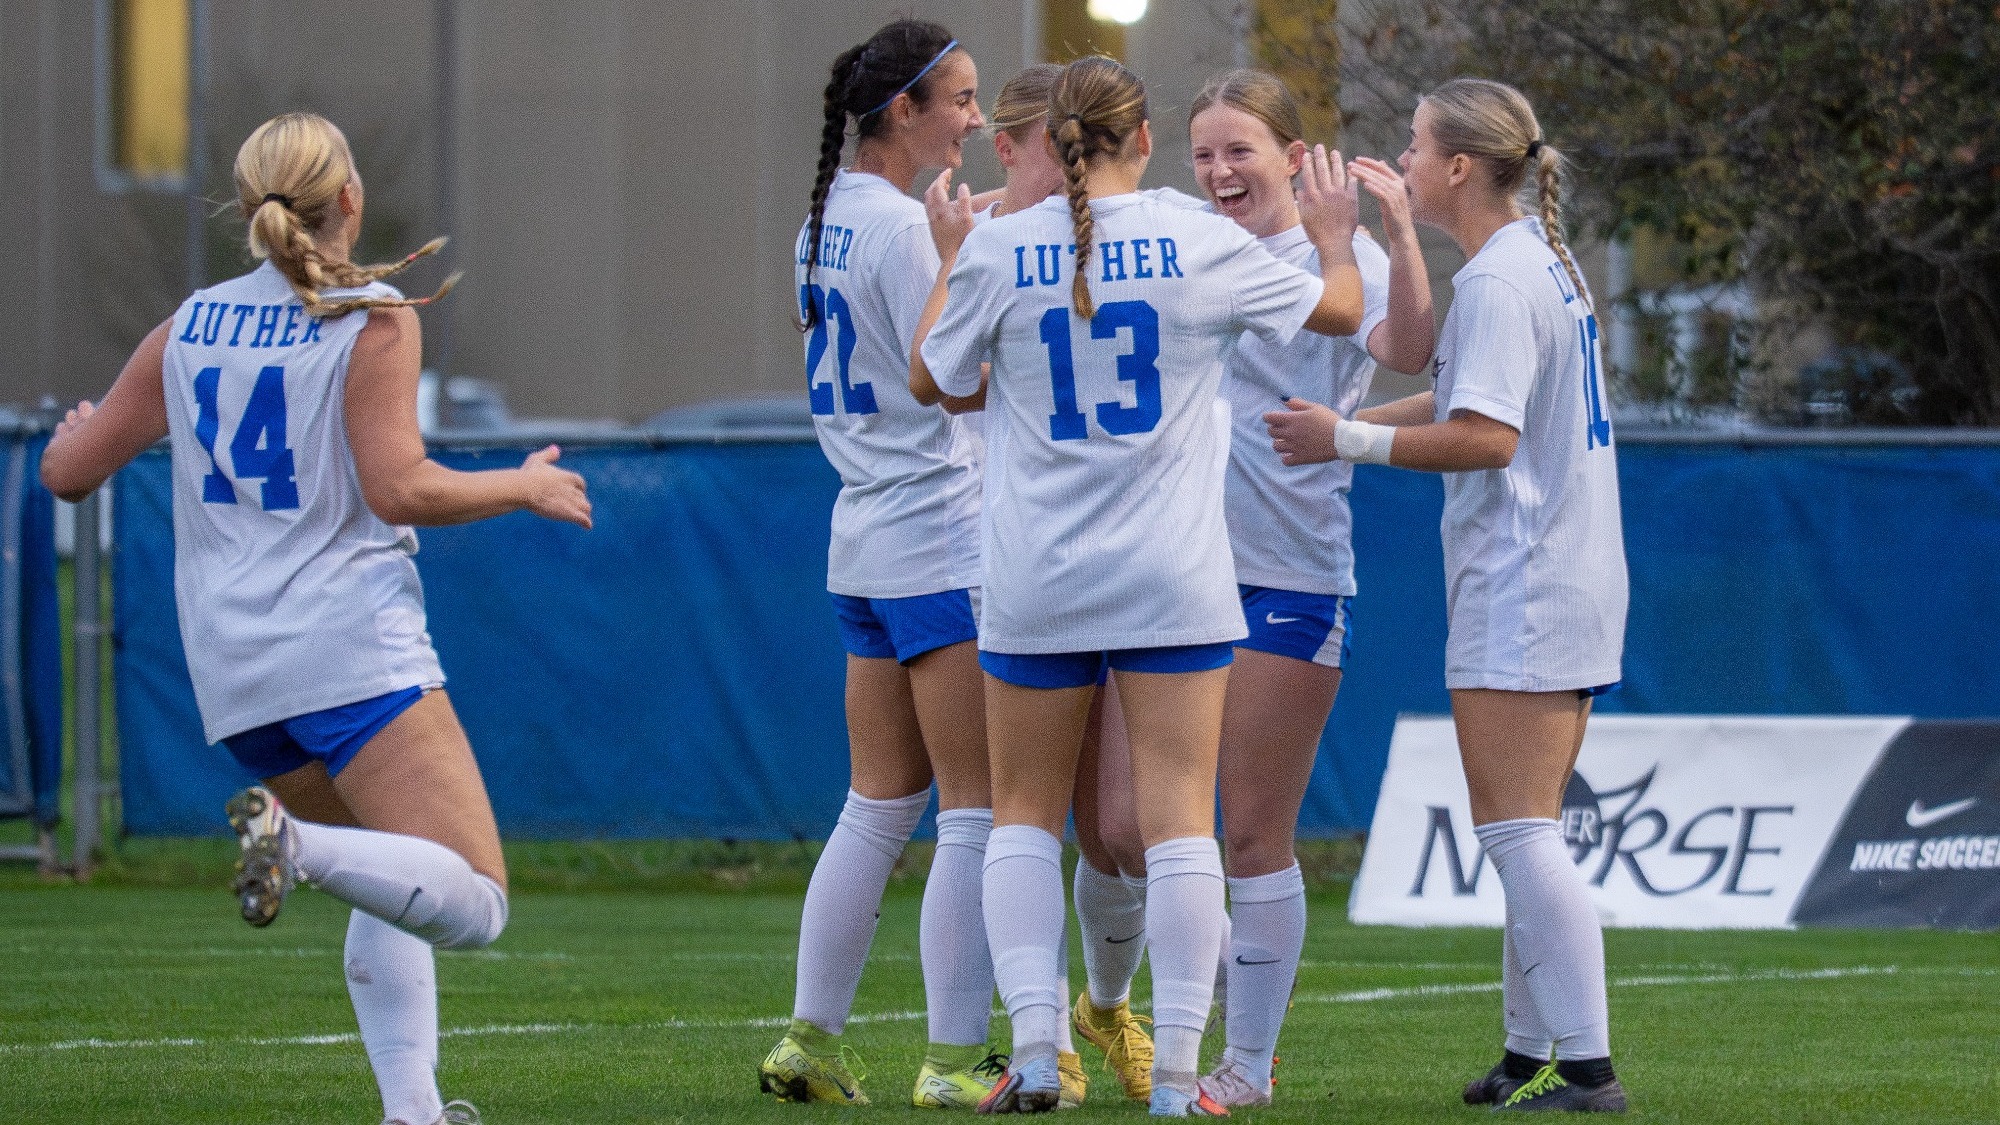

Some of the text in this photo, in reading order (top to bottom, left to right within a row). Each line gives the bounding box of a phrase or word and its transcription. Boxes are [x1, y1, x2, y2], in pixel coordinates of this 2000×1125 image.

[1014, 237, 1184, 289] LUHER
[800, 283, 880, 415] 22
[1039, 300, 1162, 442] 13
[193, 366, 300, 512] 14
[1850, 841, 1916, 871] NIKE
